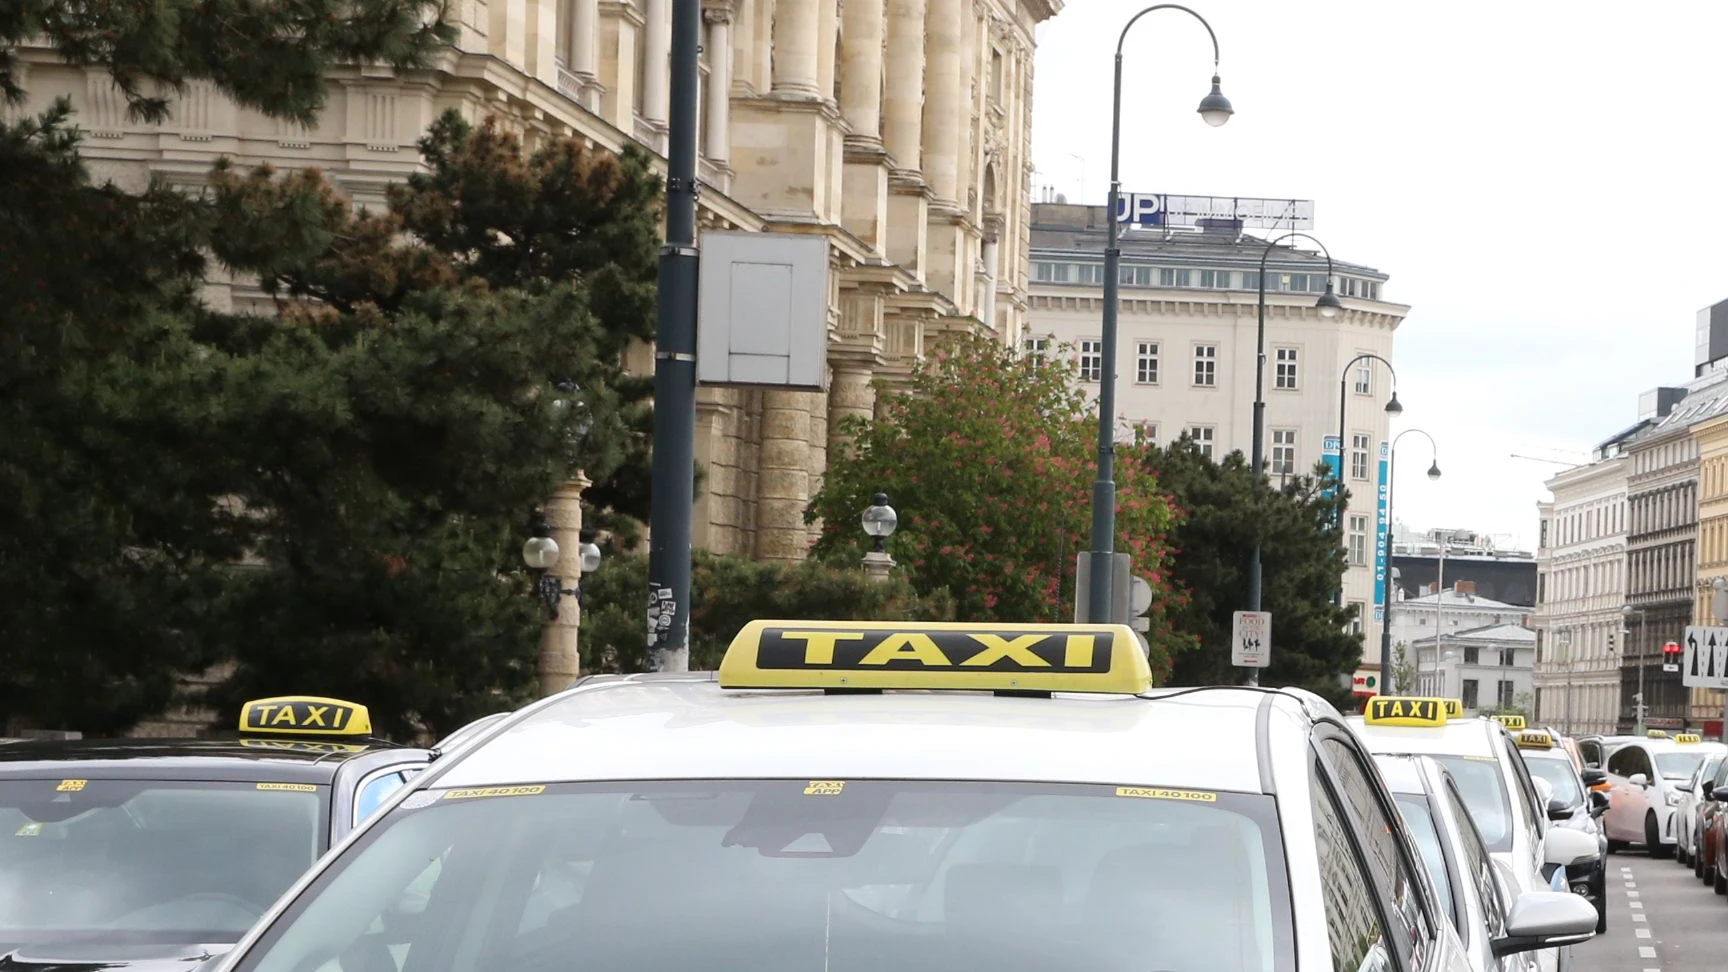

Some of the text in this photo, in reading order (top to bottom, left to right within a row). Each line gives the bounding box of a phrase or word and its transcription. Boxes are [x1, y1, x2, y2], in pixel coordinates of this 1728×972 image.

[781, 631, 1095, 668] TAXI
[257, 705, 344, 728] TAXI
[1377, 701, 1434, 718] TAXI
[1524, 733, 1546, 744] TAXI
[451, 789, 485, 797] TAXI
[1121, 788, 1213, 800] TAXI 40 100
